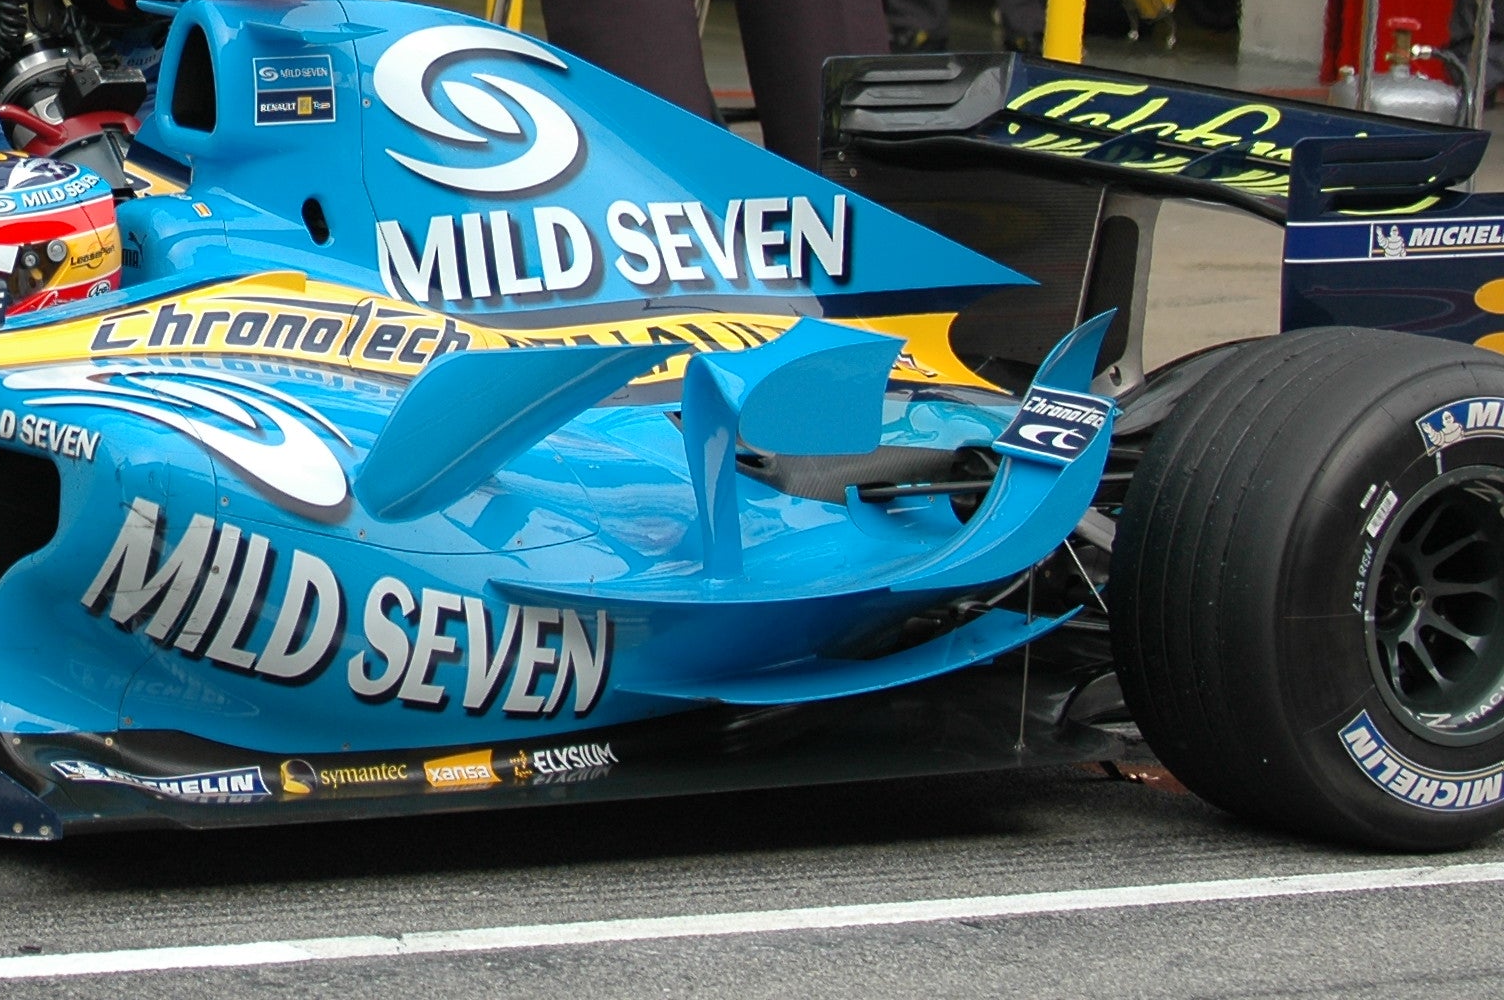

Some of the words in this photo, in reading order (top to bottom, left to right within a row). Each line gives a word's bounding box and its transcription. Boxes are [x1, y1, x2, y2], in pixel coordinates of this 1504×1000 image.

[126, 52, 158, 67] eam
[260, 102, 297, 114] RENAULT
[22, 185, 66, 209] MILD
[376, 205, 595, 302] MILD
[608, 193, 848, 286] SEVEN
[1408, 225, 1504, 248] MICHEL
[1023, 395, 1108, 427] ChronoTec
[19, 413, 100, 462] SEVEN
[81, 497, 342, 678] MILD
[347, 576, 608, 713] SEVEN
[534, 743, 620, 774] ELYSIUM
[1344, 724, 1504, 807] MICHELIN
[320, 761, 408, 788] symantec
[427, 764, 490, 783] xansa
